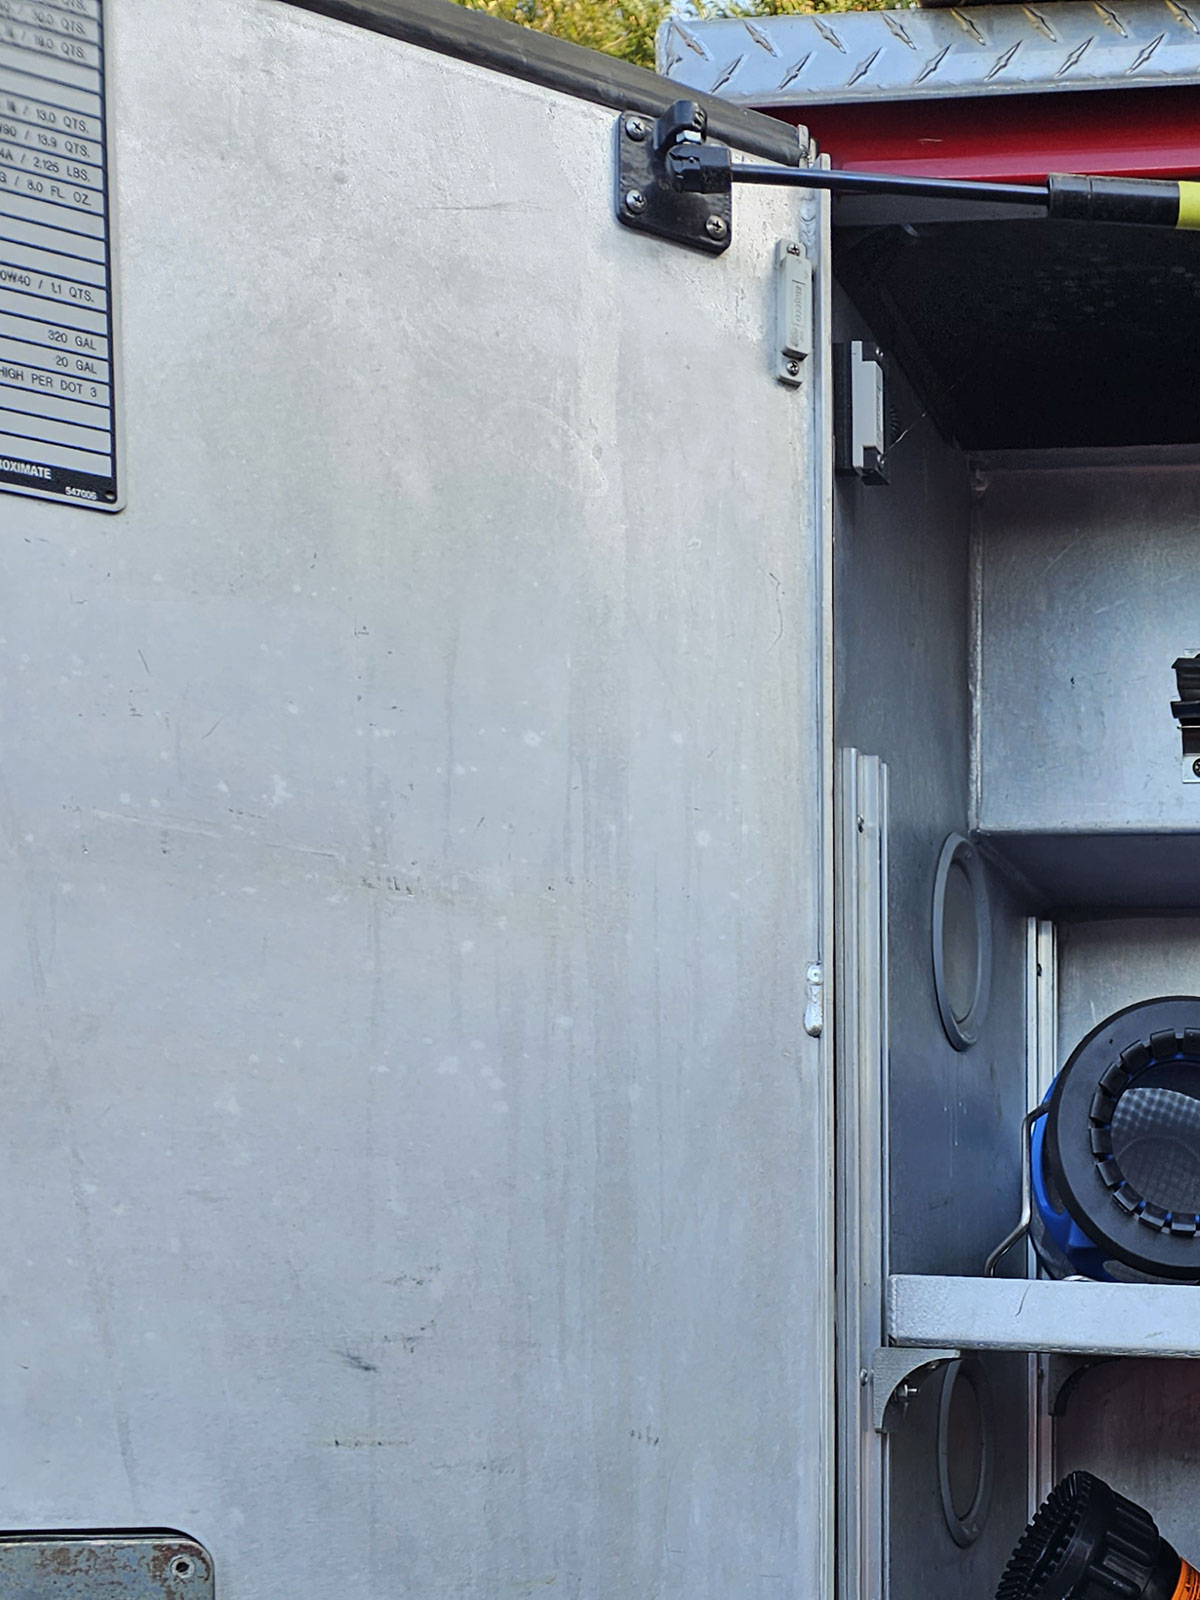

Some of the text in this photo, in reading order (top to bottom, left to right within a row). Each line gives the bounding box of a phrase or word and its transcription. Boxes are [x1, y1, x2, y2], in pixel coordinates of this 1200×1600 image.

[36, 108, 56, 124] 13.0
[63, 115, 90, 134] QTS.
[64, 140, 90, 158] QTS.
[33, 156, 60, 173] 2.125
[66, 165, 91, 182] LBS.
[68, 286, 95, 303] QTS.
[47, 329, 97, 351] 320 GAL
[55, 355, 97, 375] 20 GAL
[31, 373, 54, 388] PER
[60, 379, 83, 394] DOT
[89, 386, 98, 398] 3
